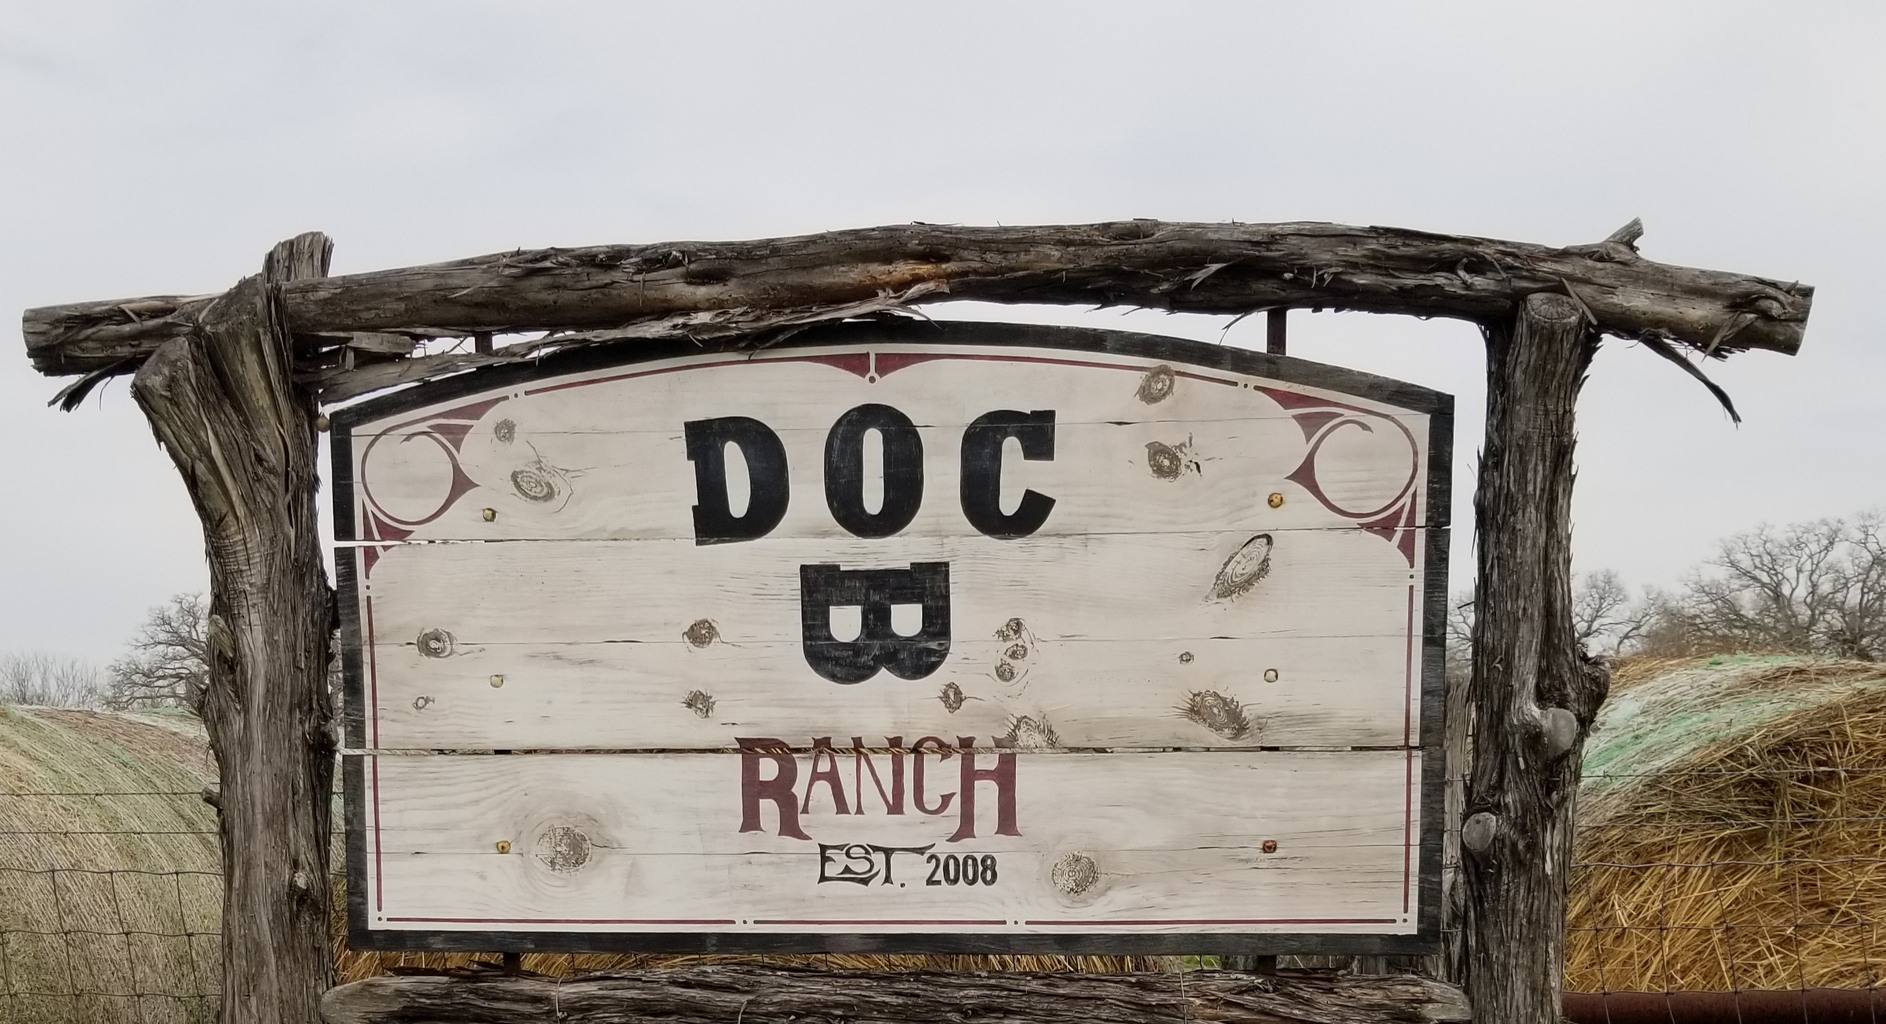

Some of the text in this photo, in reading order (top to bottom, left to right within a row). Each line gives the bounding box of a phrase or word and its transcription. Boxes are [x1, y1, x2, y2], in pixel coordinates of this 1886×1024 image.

[684, 403, 1056, 546] DOC
[800, 561, 951, 685] B
[734, 736, 1022, 842] RANCH
[817, 843, 998, 888] EST. 2008
